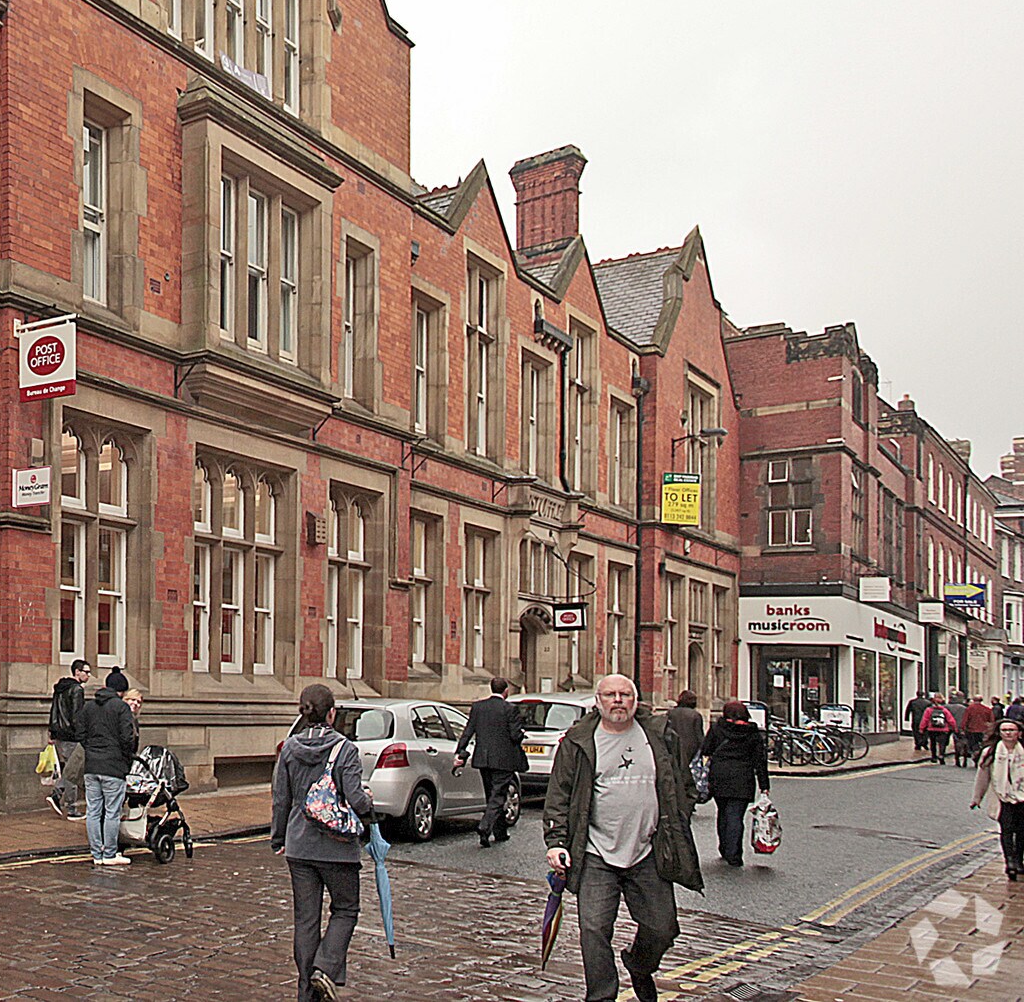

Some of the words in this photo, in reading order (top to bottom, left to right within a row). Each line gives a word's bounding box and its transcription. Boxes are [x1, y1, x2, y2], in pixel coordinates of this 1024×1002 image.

[35, 342, 58, 356] POST
[30, 353, 61, 368] OFFICE
[26, 389, 42, 397] Bureau
[18, 483, 49, 492] MoneyGram
[664, 492, 678, 502] TO
[681, 493, 698, 503] LET
[766, 603, 810, 616] banks
[748, 619, 830, 631] musicroom
